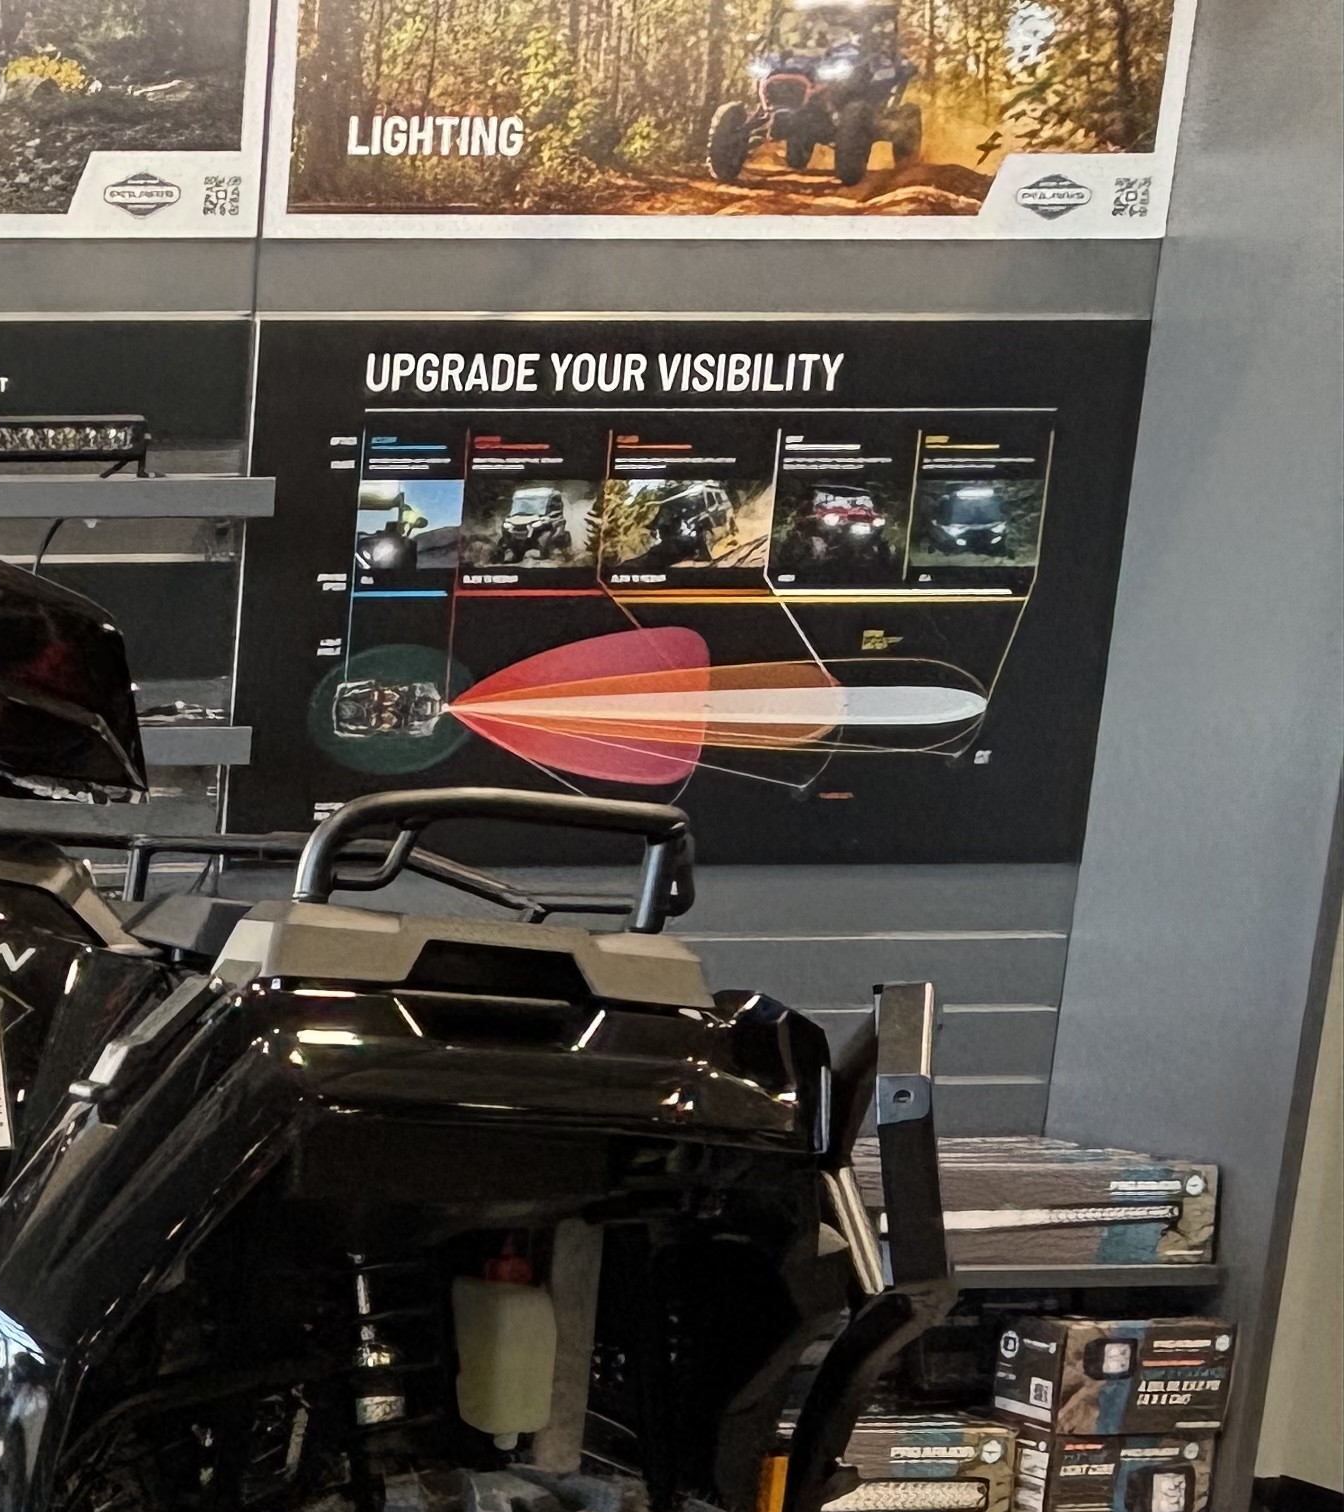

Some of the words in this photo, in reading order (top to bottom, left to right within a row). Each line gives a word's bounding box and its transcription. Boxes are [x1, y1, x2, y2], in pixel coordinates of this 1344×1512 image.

[346, 115, 525, 158] LIGHTING
[365, 352, 538, 393] UPGRADE
[549, 352, 647, 393] YOUR
[656, 352, 845, 393] VISIBILITY
